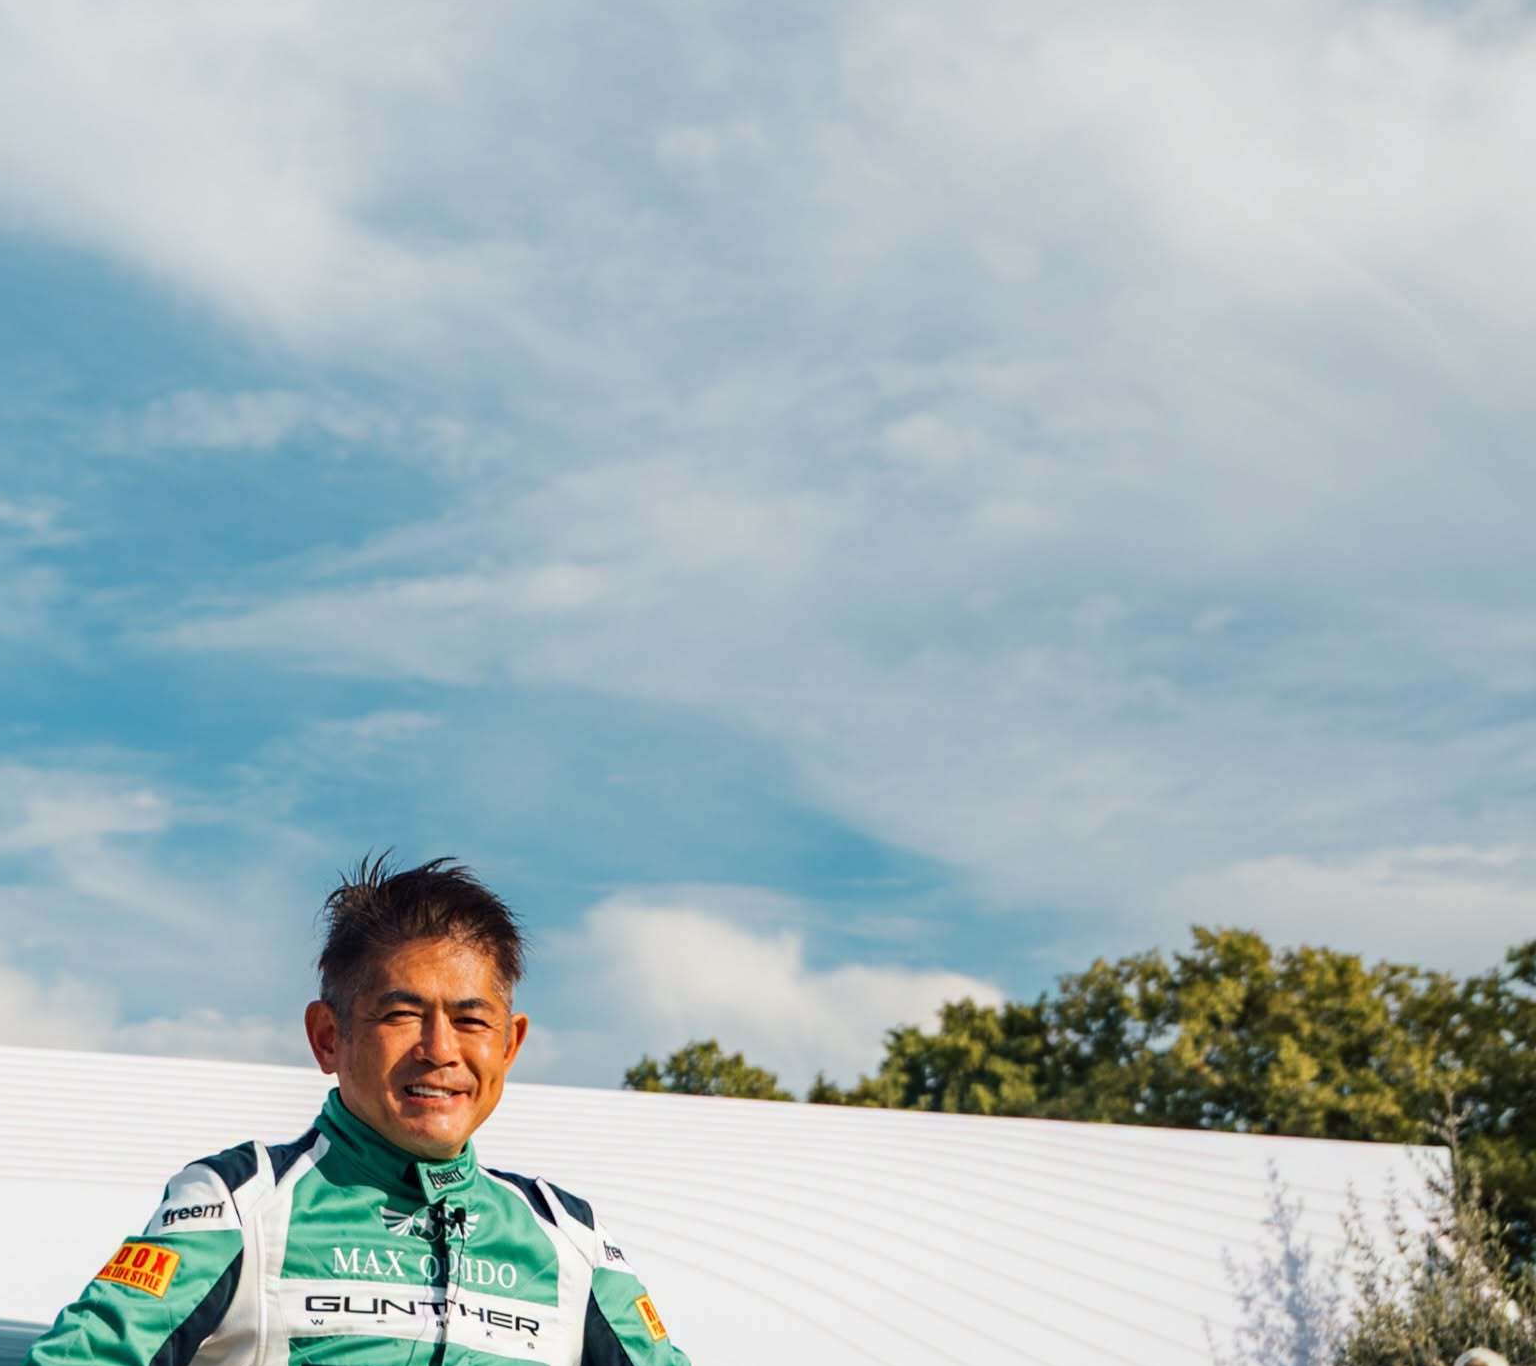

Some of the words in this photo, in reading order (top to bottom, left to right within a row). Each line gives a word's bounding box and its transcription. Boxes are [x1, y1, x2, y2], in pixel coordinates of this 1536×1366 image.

[162, 1201, 226, 1227] freem
[332, 1246, 406, 1278] MAX
[305, 1295, 540, 1337] GUNTHER
